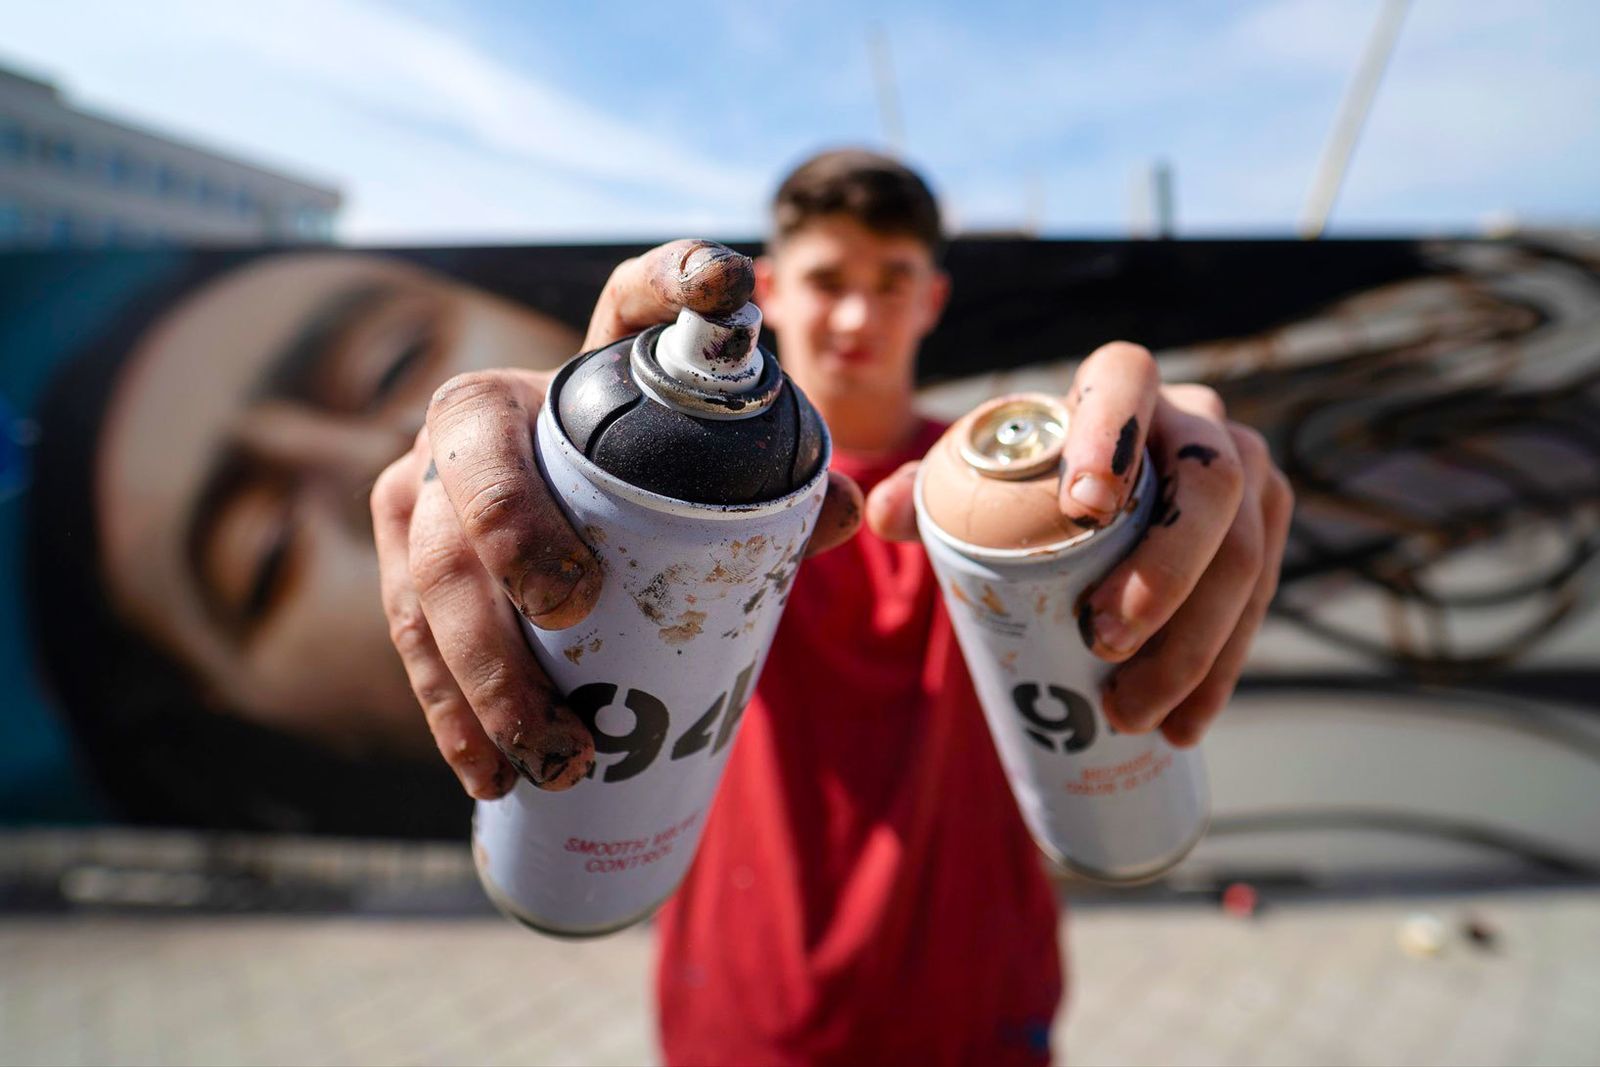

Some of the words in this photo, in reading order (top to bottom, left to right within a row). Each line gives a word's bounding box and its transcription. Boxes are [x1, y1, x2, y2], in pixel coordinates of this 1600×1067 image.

[566, 656, 758, 783] 94
[1012, 683, 1117, 755] 9
[563, 836, 649, 857] SMOOTH
